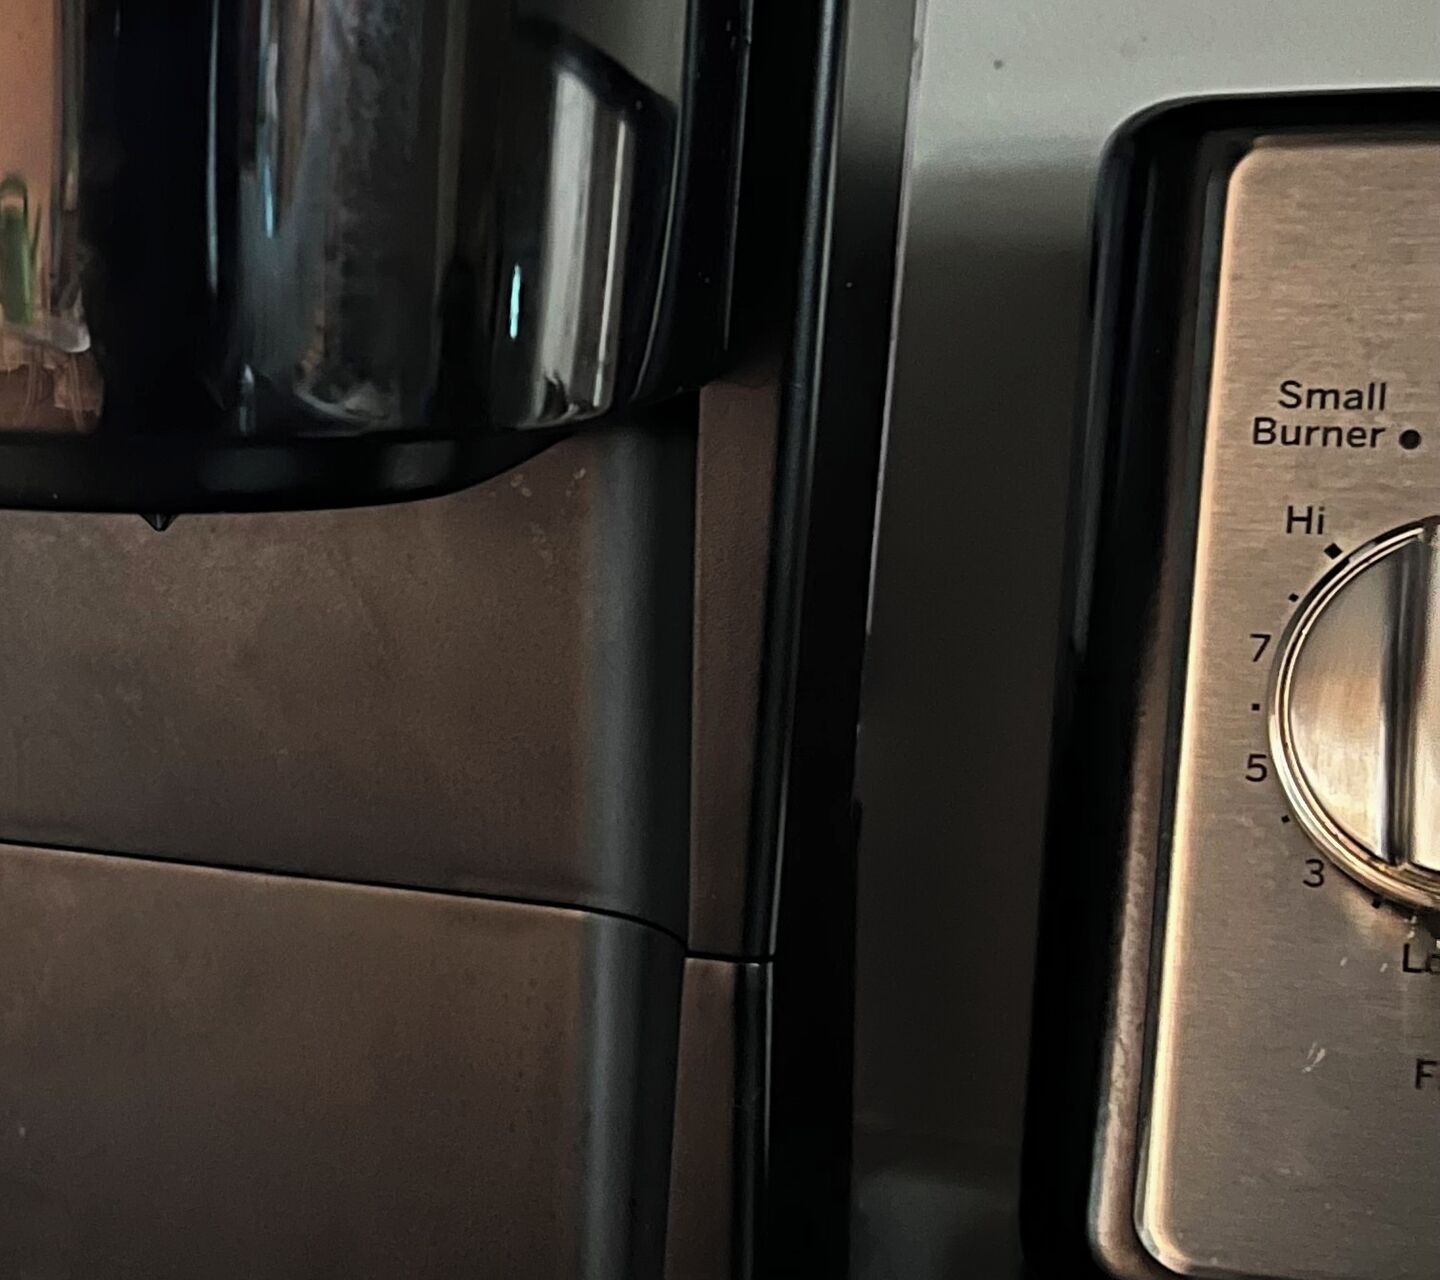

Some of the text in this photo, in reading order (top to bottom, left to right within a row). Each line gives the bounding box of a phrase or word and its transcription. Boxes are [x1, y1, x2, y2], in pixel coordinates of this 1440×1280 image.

[1278, 380, 1388, 411] Small
[1252, 417, 1387, 448] Burner
[1286, 505, 1326, 535] Hi
[1249, 633, 1272, 663] 7
[1245, 753, 1268, 783] 5
[1302, 858, 1325, 888] 3
